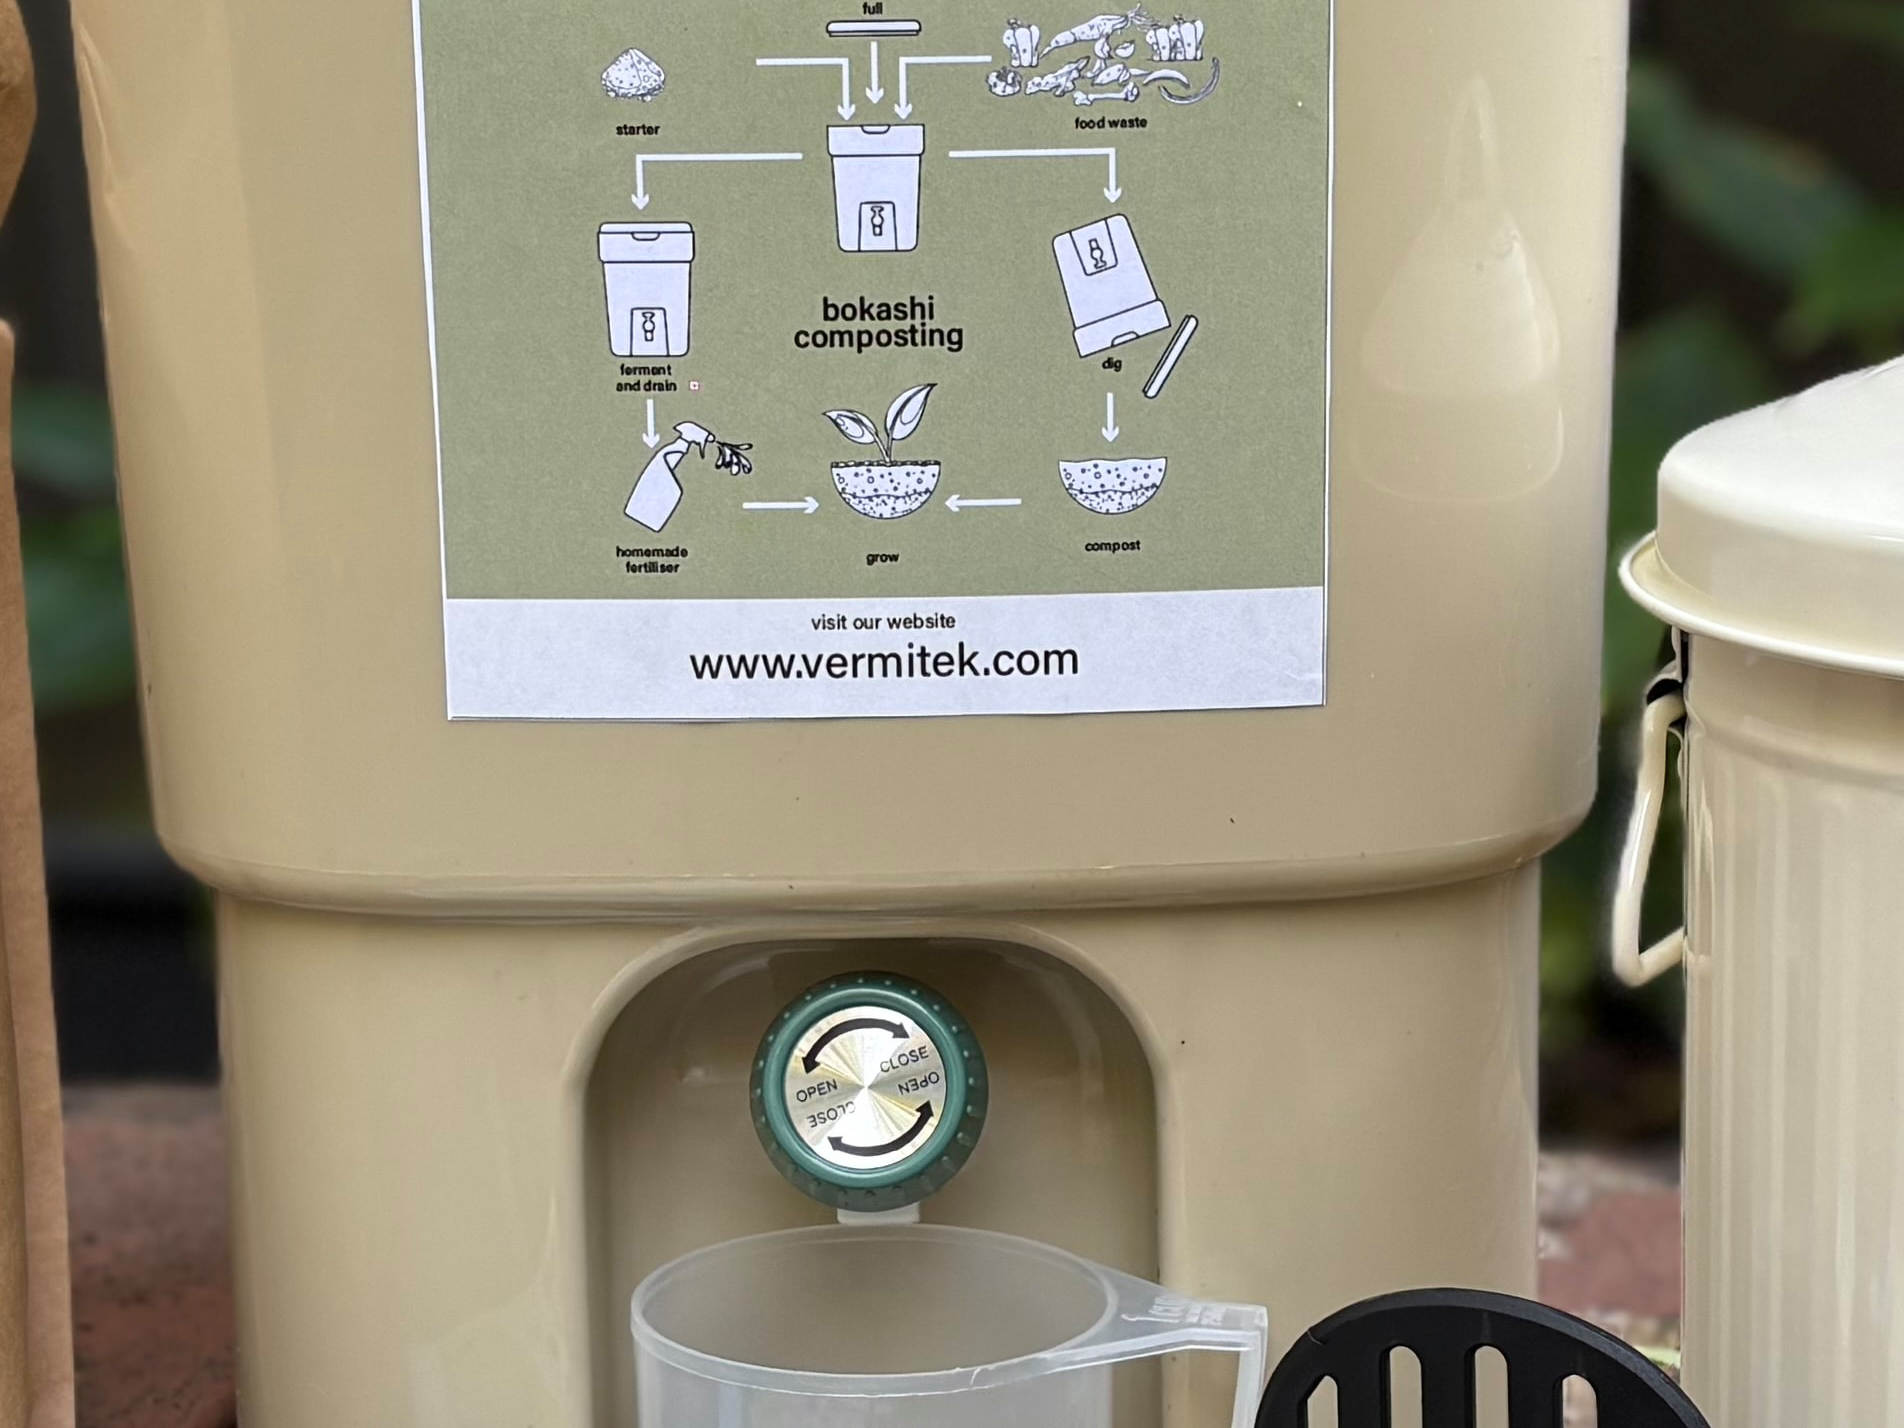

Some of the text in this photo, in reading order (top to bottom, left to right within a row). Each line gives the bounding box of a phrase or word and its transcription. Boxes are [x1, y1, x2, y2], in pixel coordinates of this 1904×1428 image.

[862, 1, 884, 16] full
[615, 123, 661, 136] starter
[1074, 115, 1148, 130] food waste
[822, 294, 935, 322] bokashi
[793, 321, 964, 355] composting
[619, 363, 673, 376] ferment
[615, 379, 678, 392] and drain
[615, 545, 689, 558] homemade
[1084, 539, 1141, 554] compost
[625, 560, 680, 574] fertiliser
[865, 553, 900, 566] grow
[811, 612, 956, 631] visit our website
[689, 641, 1078, 680] www.vermitek.com
[880, 1045, 929, 1073] CLOSE
[796, 1079, 838, 1103] OPEN
[898, 1071, 940, 1096] OPEN
